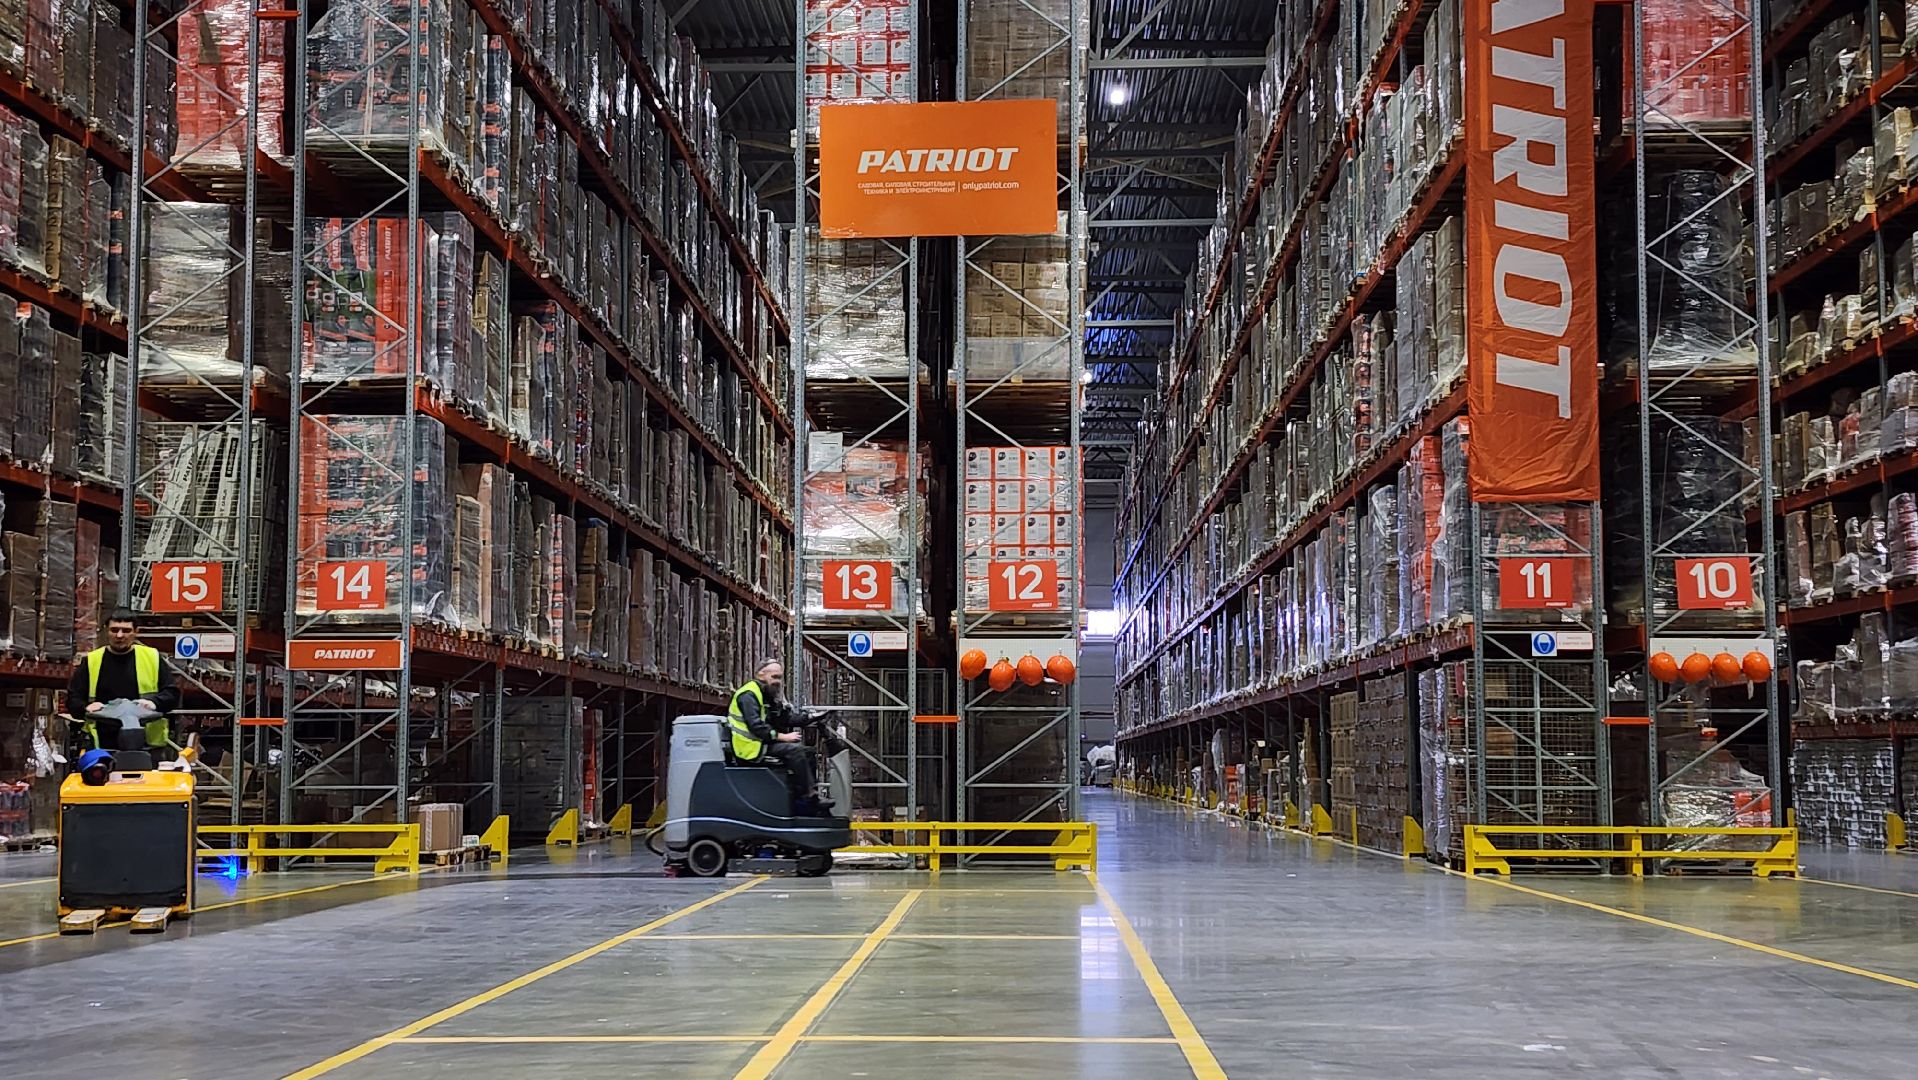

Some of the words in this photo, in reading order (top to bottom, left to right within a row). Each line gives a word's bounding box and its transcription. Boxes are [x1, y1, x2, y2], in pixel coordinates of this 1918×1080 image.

[857, 147, 1019, 174] PATRIOT
[962, 181, 1019, 191] onlypatriot.com
[164, 566, 208, 602] 15
[330, 565, 371, 600] 14
[835, 564, 878, 600] 13
[1001, 564, 1044, 600] 12
[1519, 562, 1552, 598] 11
[1689, 562, 1737, 598] 10
[314, 649, 376, 660] PATRIOT
